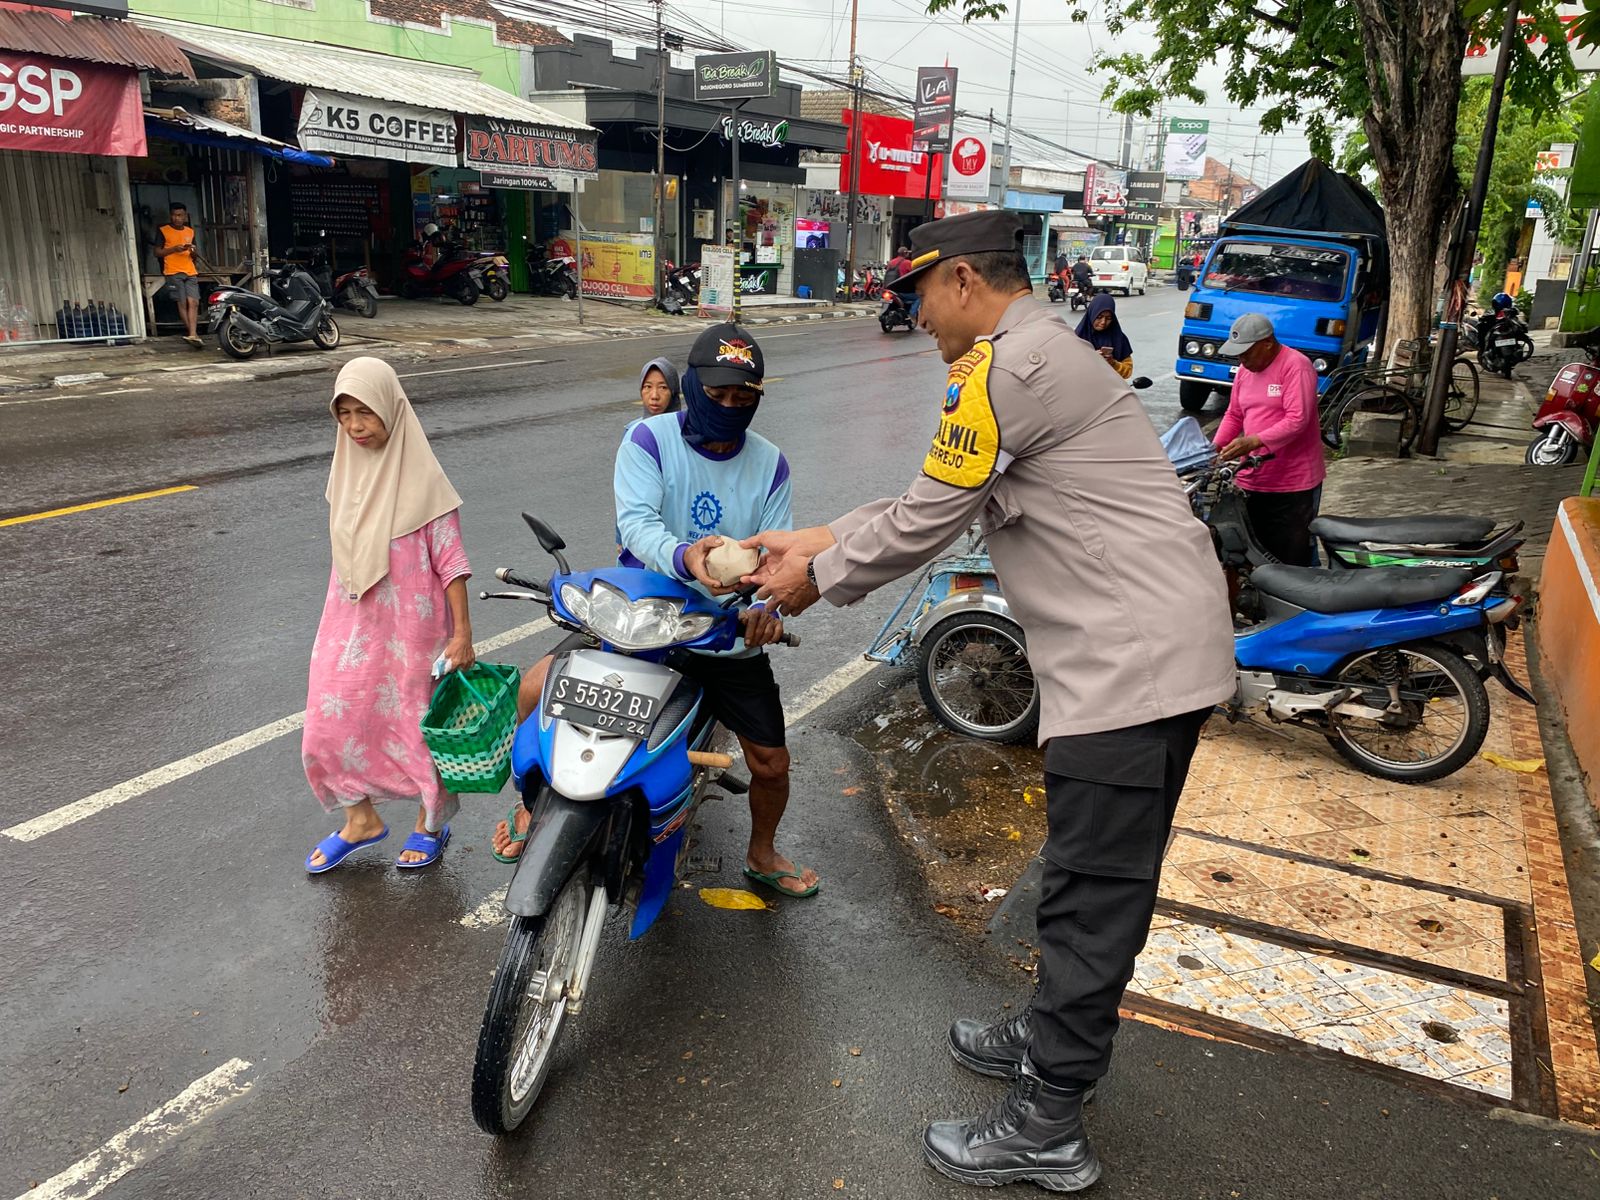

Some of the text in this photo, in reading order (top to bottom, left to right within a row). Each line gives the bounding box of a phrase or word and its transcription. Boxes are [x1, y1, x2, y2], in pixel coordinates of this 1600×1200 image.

[701, 64, 749, 80] Tea Break
[19, 125, 84, 138] PARTNERSHIP
[326, 106, 456, 144] K5 COFFEE
[508, 123, 577, 143] Aromawangi
[742, 122, 772, 141] Break
[468, 130, 597, 170] PARFUMS
[493, 176, 521, 186] Jaringan
[521, 178, 538, 187] 100%
[611, 283, 630, 294] CELL
[556, 678, 654, 720] S 5532 BJ
